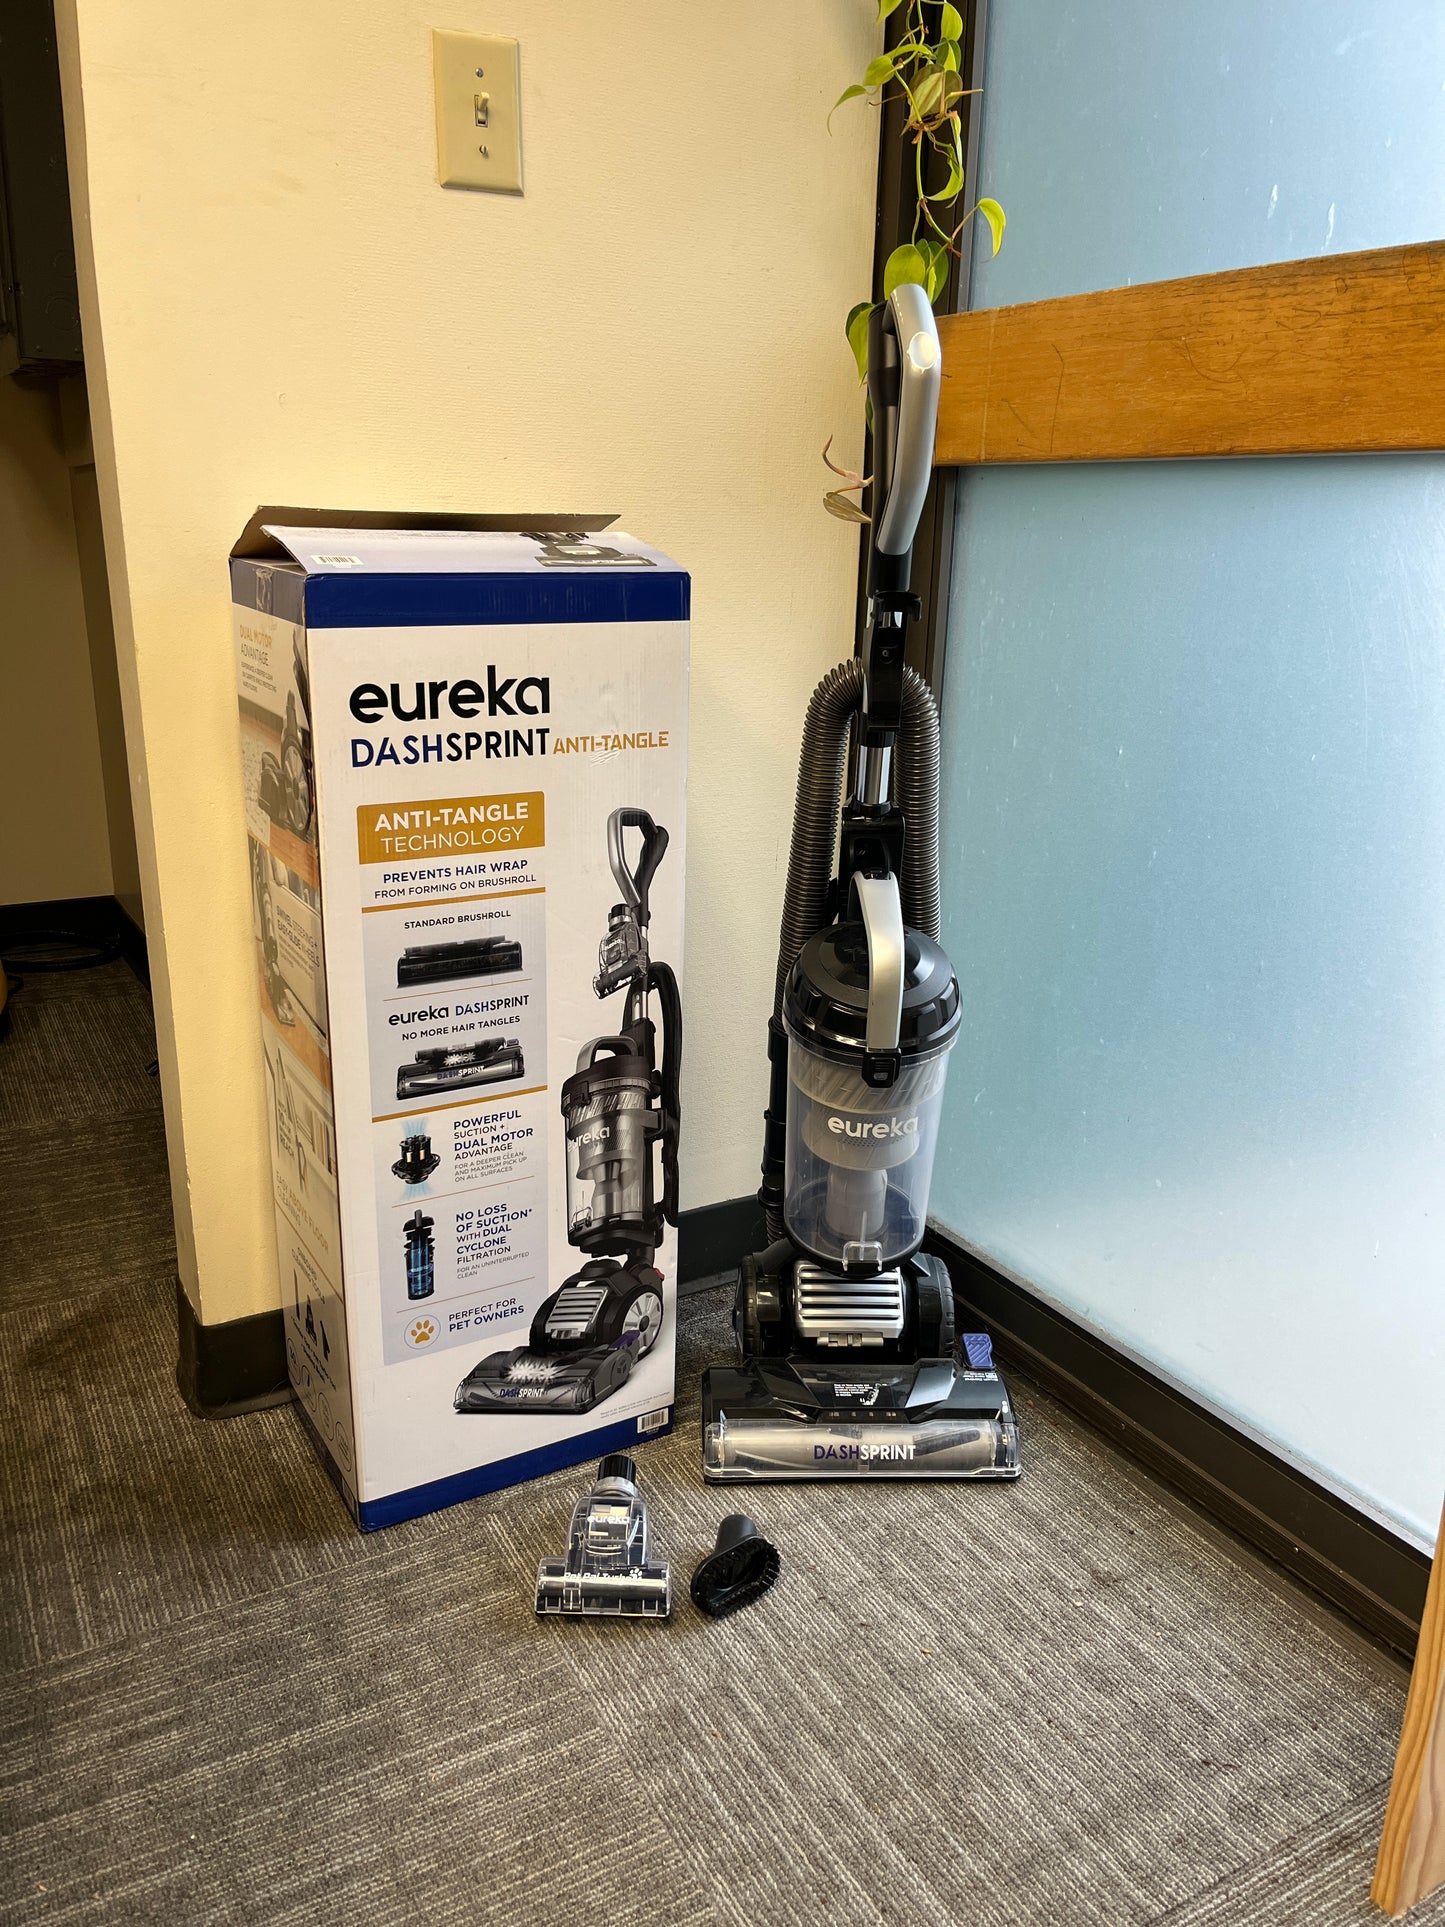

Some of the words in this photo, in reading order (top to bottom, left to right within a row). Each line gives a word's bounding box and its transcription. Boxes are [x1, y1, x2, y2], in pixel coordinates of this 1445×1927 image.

[349, 664, 550, 724] eureka
[351, 728, 550, 768] DASHSPRINT
[553, 731, 669, 754] ANTI-TANGLE
[374, 802, 528, 832] ANTI-TANGLE
[381, 825, 525, 854] TECHNOLOGY
[383, 868, 452, 884] PREVENTS
[456, 864, 486, 876] HAIR
[490, 860, 528, 872] WRAP
[375, 887, 406, 899] FROM
[409, 882, 457, 896] FORMING
[460, 881, 475, 890] ON
[478, 874, 536, 888] BRUSHROLL
[404, 916, 455, 930] STANDARD
[458, 910, 511, 924] BRUSHROLL
[388, 1005, 449, 1027] eureka
[455, 995, 530, 1017] DASHSPRINT
[402, 1032, 417, 1041] NO
[420, 1027, 449, 1038] MORE
[452, 1022, 475, 1033] HAIR
[478, 1015, 521, 1029] TANGLES
[454, 1110, 521, 1130] POWERFUL
[827, 1115, 919, 1139] eureka
[454, 1124, 497, 1140] SUCTION
[454, 1136, 487, 1151] DUAL
[491, 1128, 534, 1144] MOTOR
[454, 1142, 513, 1161] ADVANTAGE
[476, 1156, 500, 1165] DEEPER
[502, 1151, 524, 1161] CLEAN
[454, 1169, 469, 1177] AND
[470, 1163, 501, 1173] MAXIMUM
[503, 1159, 518, 1167] PICK
[454, 1175, 465, 1183] ON
[467, 1172, 478, 1180] ALL
[480, 1166, 513, 1178] SURFACES
[456, 1211, 474, 1223] NO
[478, 1204, 507, 1218] LOSS
[456, 1222, 473, 1233] OF
[456, 1232, 481, 1243] WITH
[483, 1224, 512, 1237] DUAL
[456, 1236, 507, 1255] CYCLONE
[457, 1245, 511, 1265] FILTRATION
[481, 1252, 530, 1268] UNINTERRUPTED
[457, 1270, 478, 1280] CLEAN
[449, 1303, 494, 1322] PERFECT
[496, 1297, 516, 1309] FOR
[449, 1320, 470, 1333] PET
[474, 1305, 525, 1325] OWNERS
[500, 1388, 544, 1398] DASHSPRINT
[814, 1444, 916, 1460] DASHSPRINT
[587, 1515, 630, 1524] eureka
